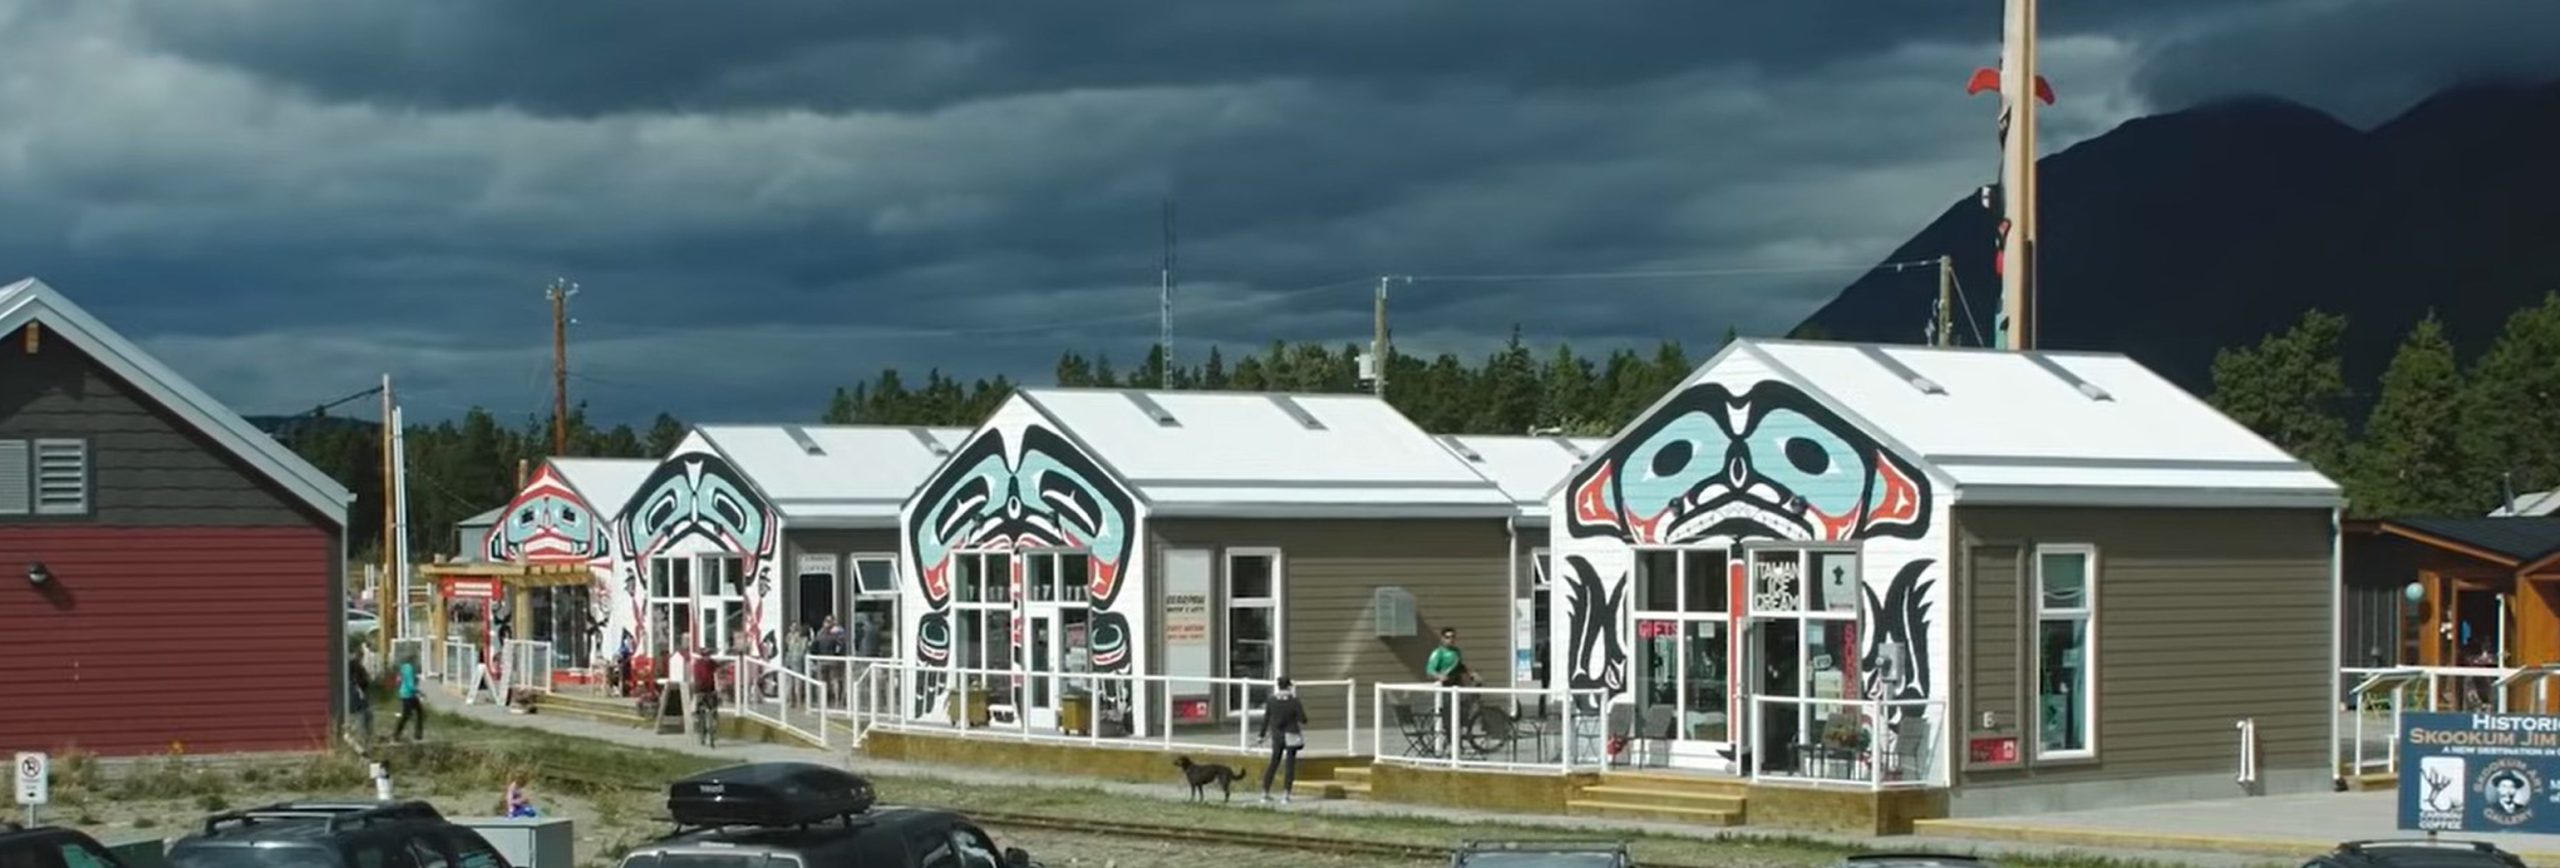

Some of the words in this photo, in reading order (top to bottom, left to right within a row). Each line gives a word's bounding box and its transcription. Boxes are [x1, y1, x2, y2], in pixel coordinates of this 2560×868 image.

[2409, 727, 2515, 745] SKOOKUM
[2520, 731, 2557, 746] JIM
[2473, 758, 2527, 792] SKOOKUM
[2483, 807, 2533, 825] GALLERY
